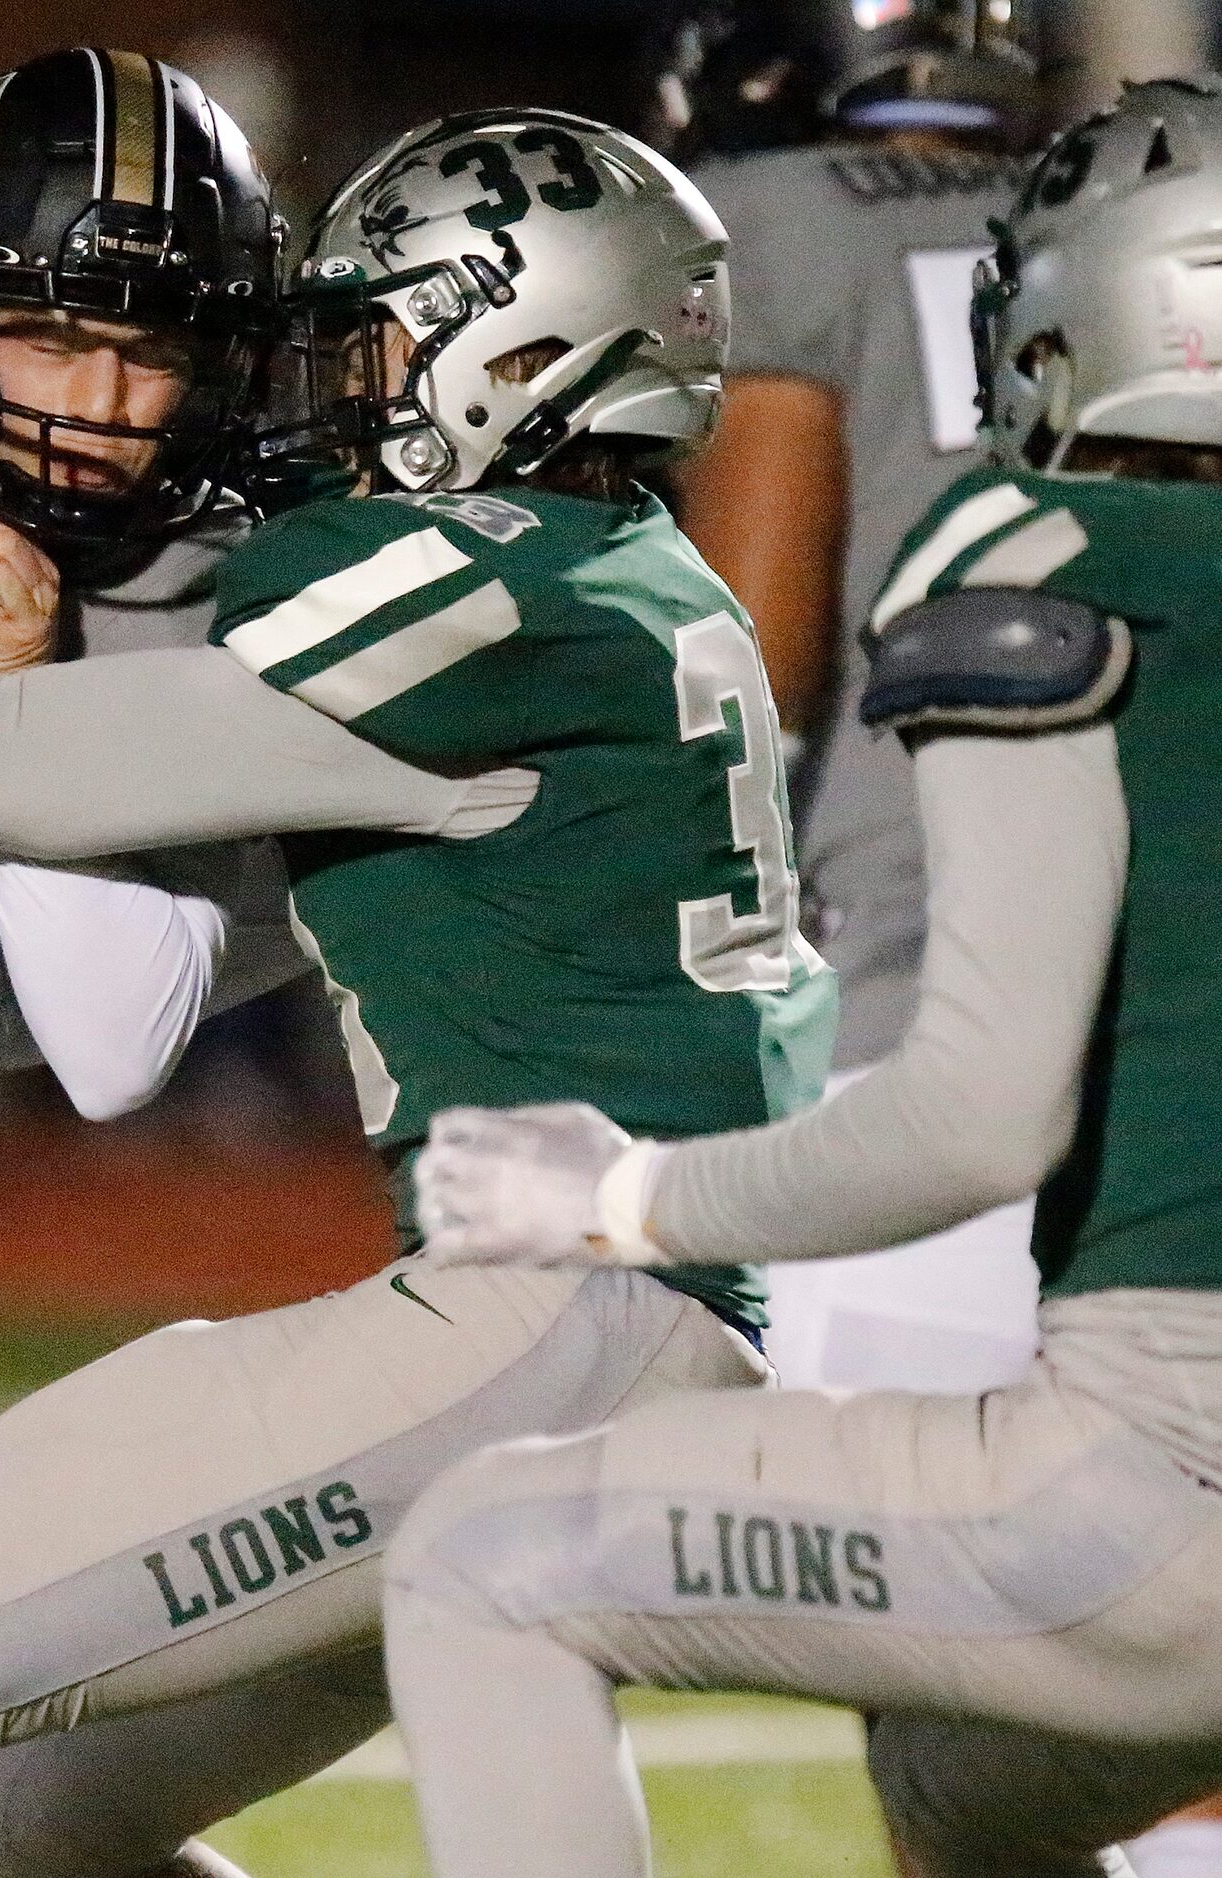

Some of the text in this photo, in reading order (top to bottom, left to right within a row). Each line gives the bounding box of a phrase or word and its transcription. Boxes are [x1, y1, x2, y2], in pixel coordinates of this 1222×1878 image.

[439, 128, 604, 231] 33
[99, 235, 119, 250] THE
[142, 1480, 373, 1628] LIONS
[667, 1506, 891, 1612] LIONS
